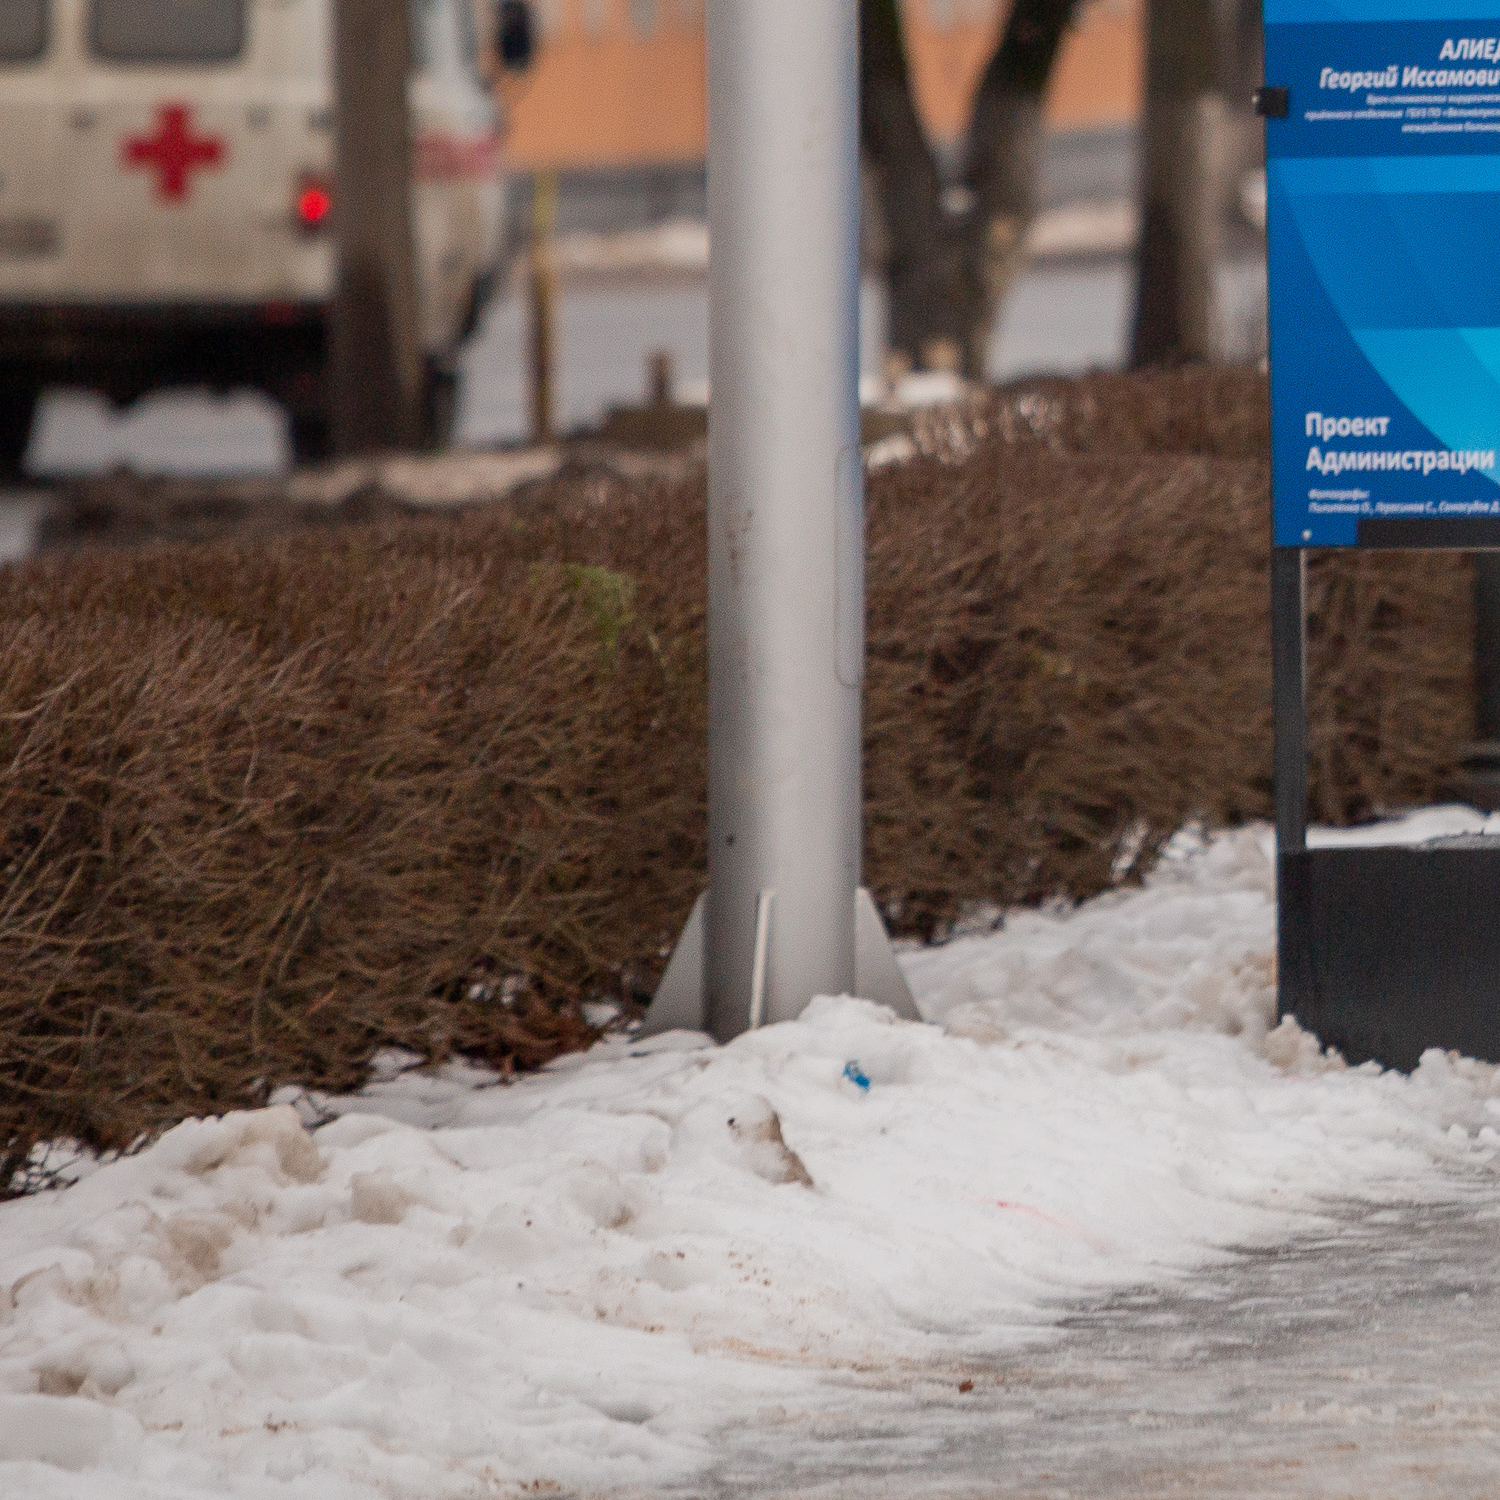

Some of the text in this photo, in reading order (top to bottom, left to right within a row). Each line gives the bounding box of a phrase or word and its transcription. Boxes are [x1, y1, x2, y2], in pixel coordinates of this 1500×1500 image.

[1319, 64, 1399, 93] Георгий
[1305, 411, 1390, 442] Проект
[1305, 445, 1496, 476] Администрации
